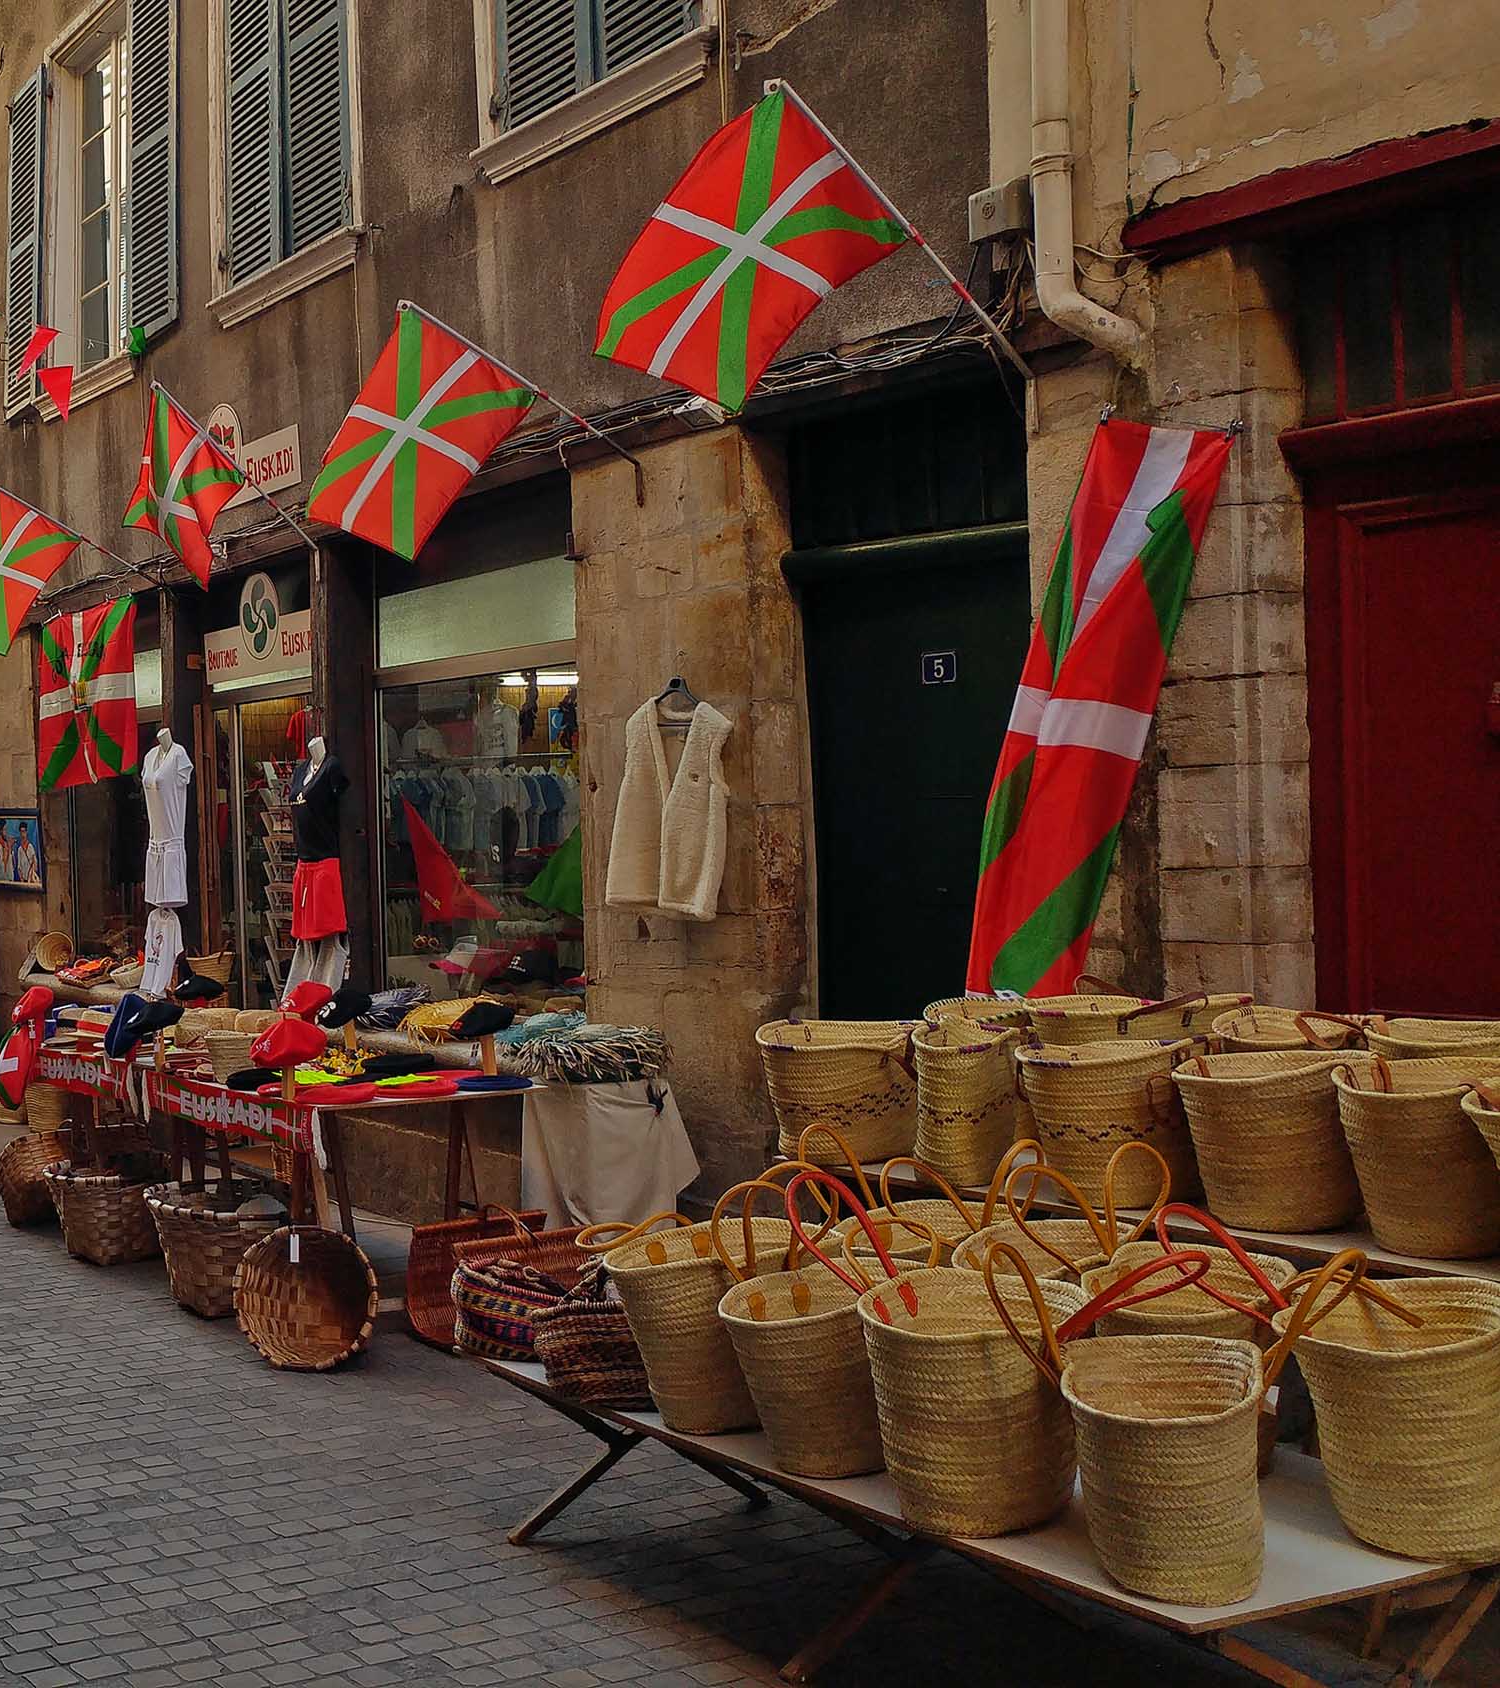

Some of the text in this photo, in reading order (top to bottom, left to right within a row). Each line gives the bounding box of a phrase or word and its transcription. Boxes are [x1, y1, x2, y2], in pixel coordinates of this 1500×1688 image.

[934, 658, 944, 678] 5
[39, 1055, 101, 1086] EUSKADI
[179, 1089, 273, 1133] EUSKADI
